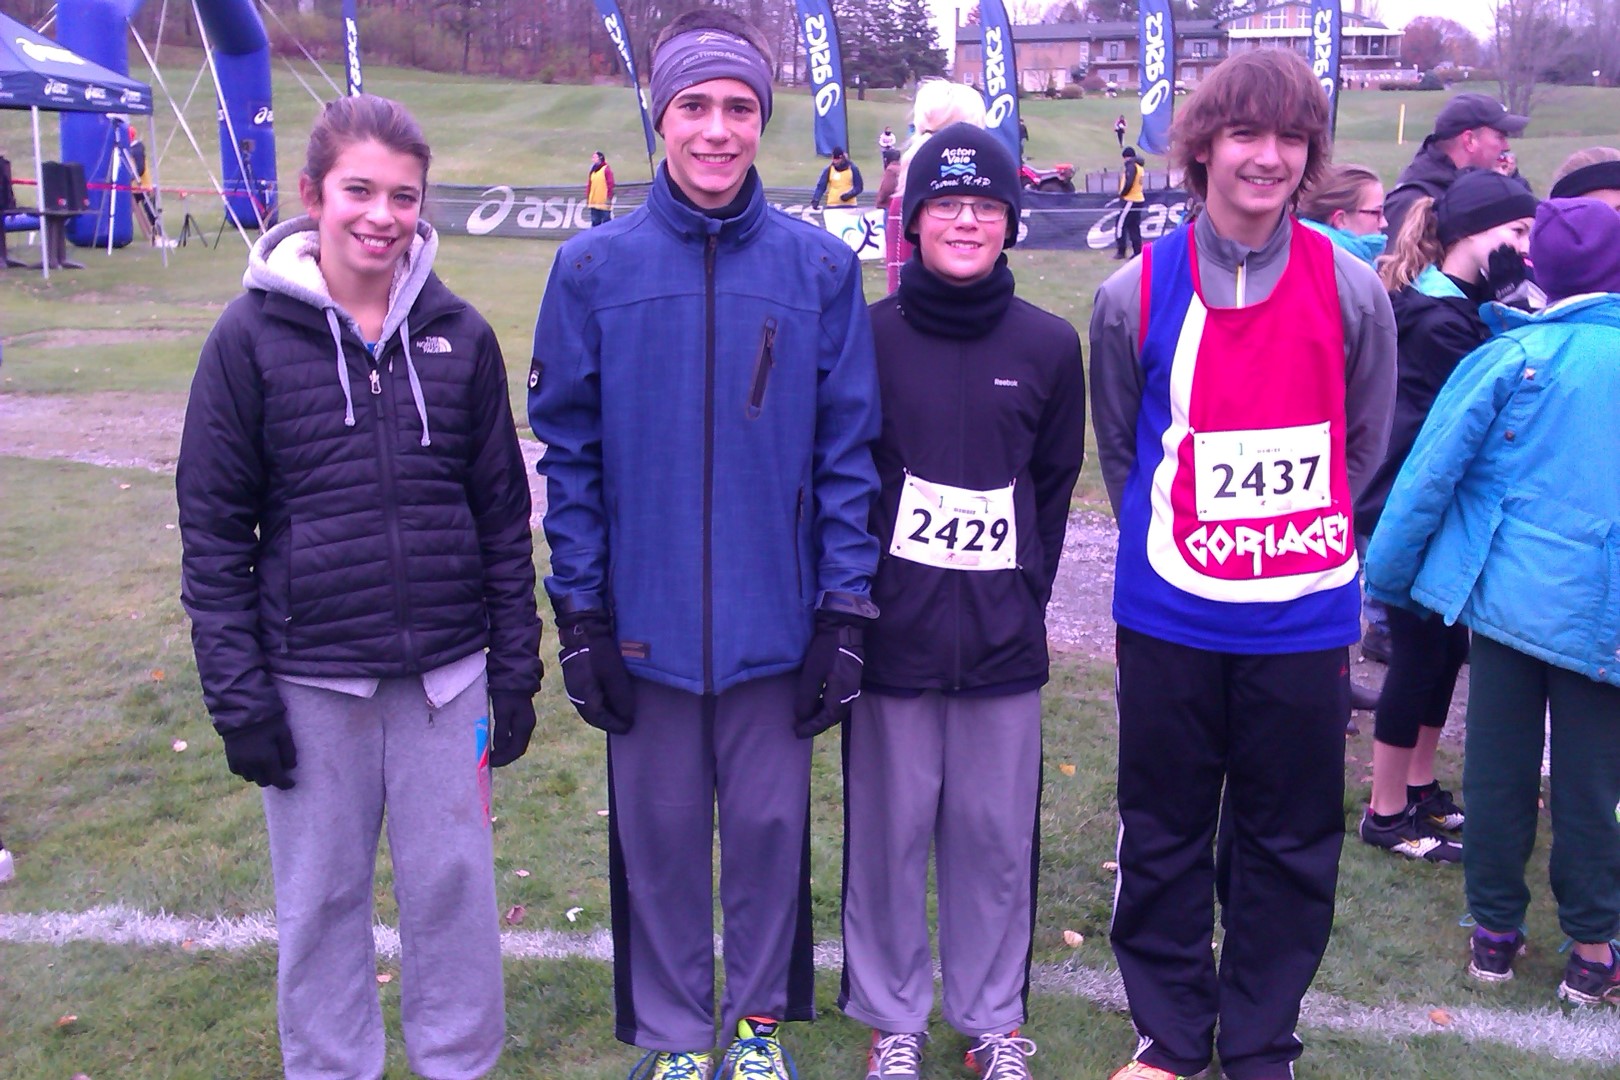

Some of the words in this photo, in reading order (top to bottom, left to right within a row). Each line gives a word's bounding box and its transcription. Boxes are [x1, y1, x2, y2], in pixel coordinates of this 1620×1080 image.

[941, 147, 976, 158] Acton
[947, 156, 971, 165] Vale
[994, 378, 1018, 387] Reebok
[1212, 455, 1320, 498] 2437
[908, 508, 1009, 552] 2429
